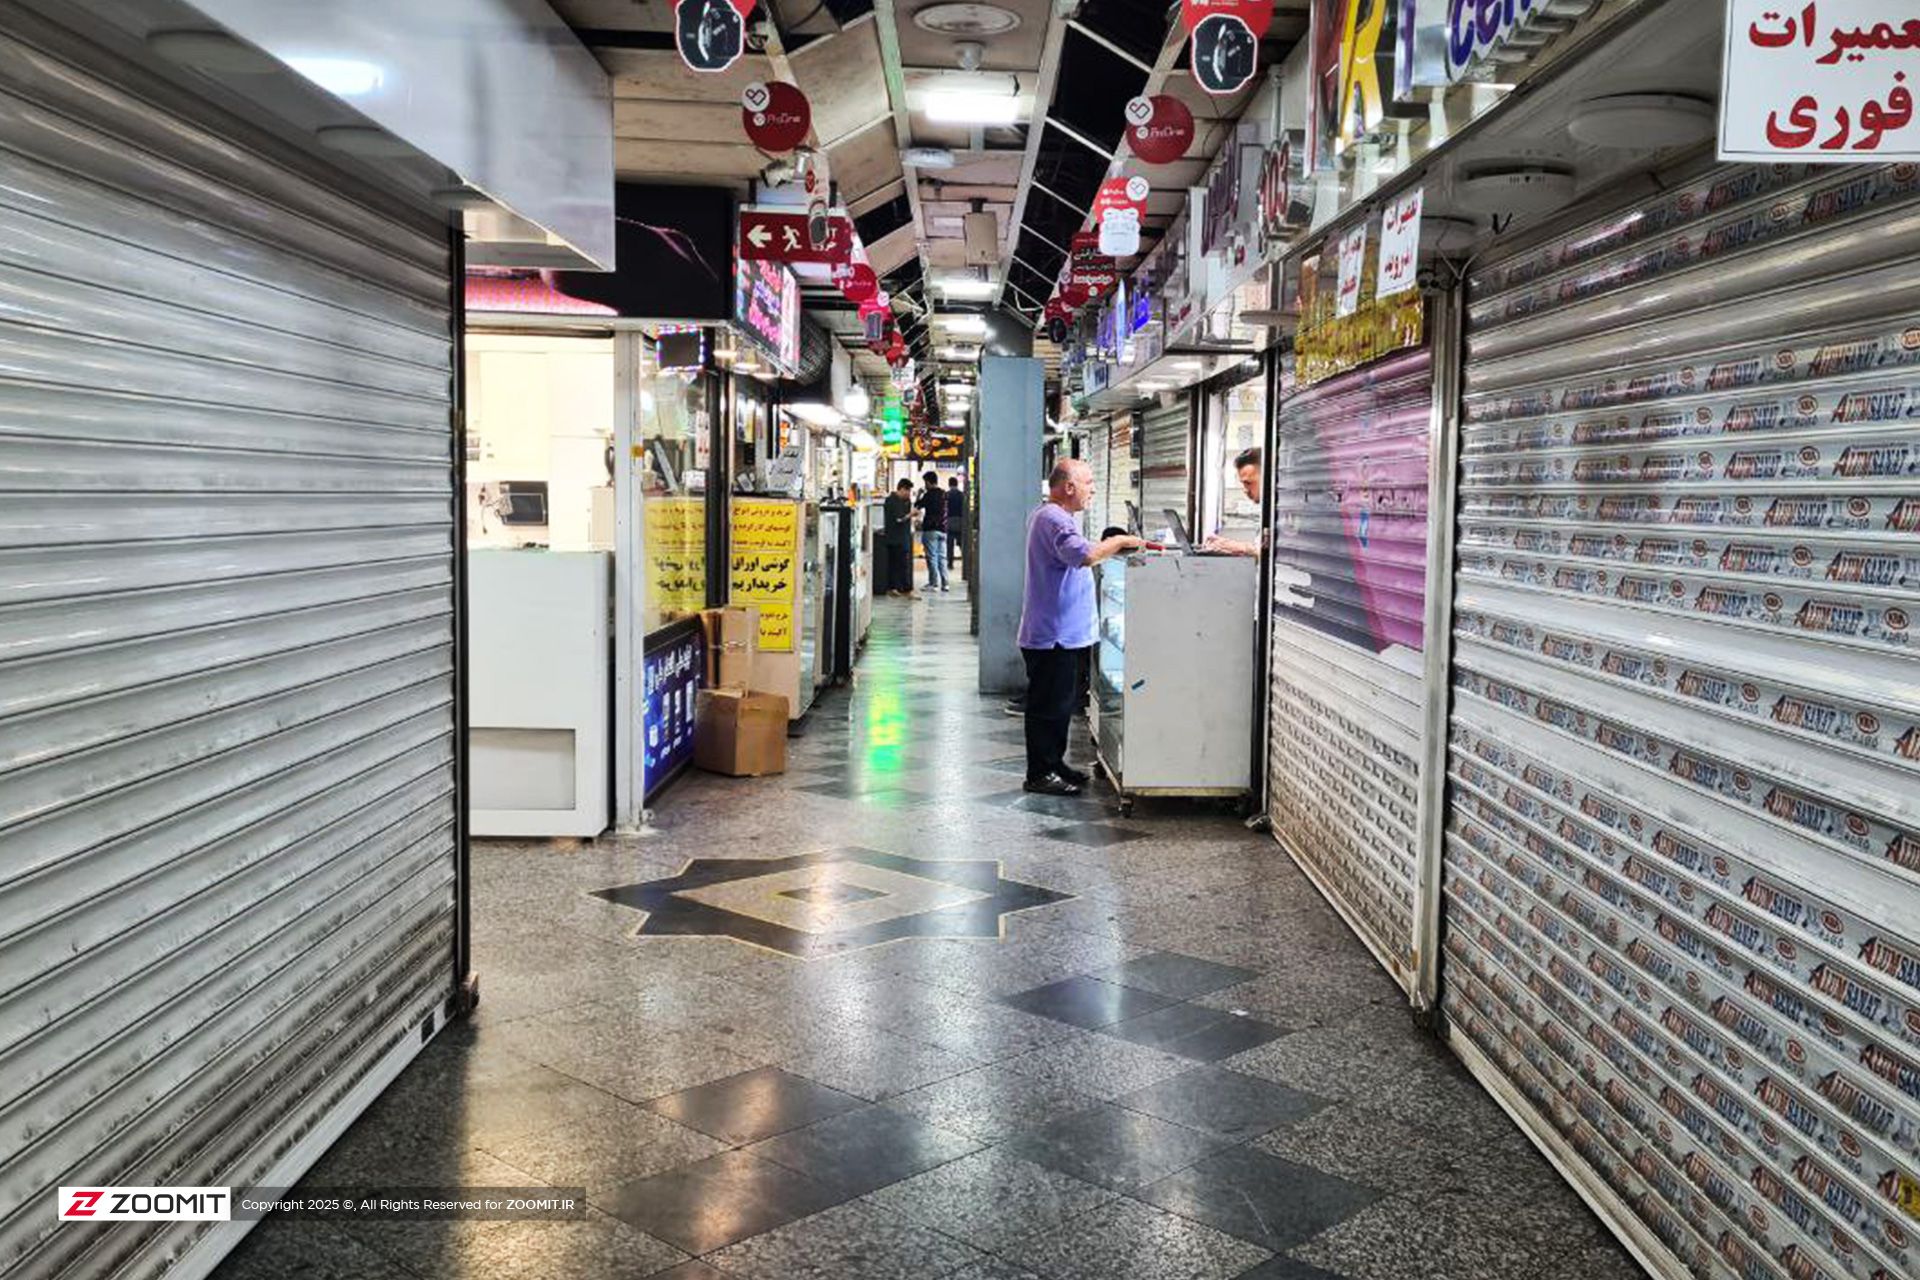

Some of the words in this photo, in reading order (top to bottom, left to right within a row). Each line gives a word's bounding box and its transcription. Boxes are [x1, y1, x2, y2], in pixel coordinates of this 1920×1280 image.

[1766, 71, 1913, 150] فوری
[761, 558, 790, 573] گوشی
[732, 578, 787, 592] خریداریم
